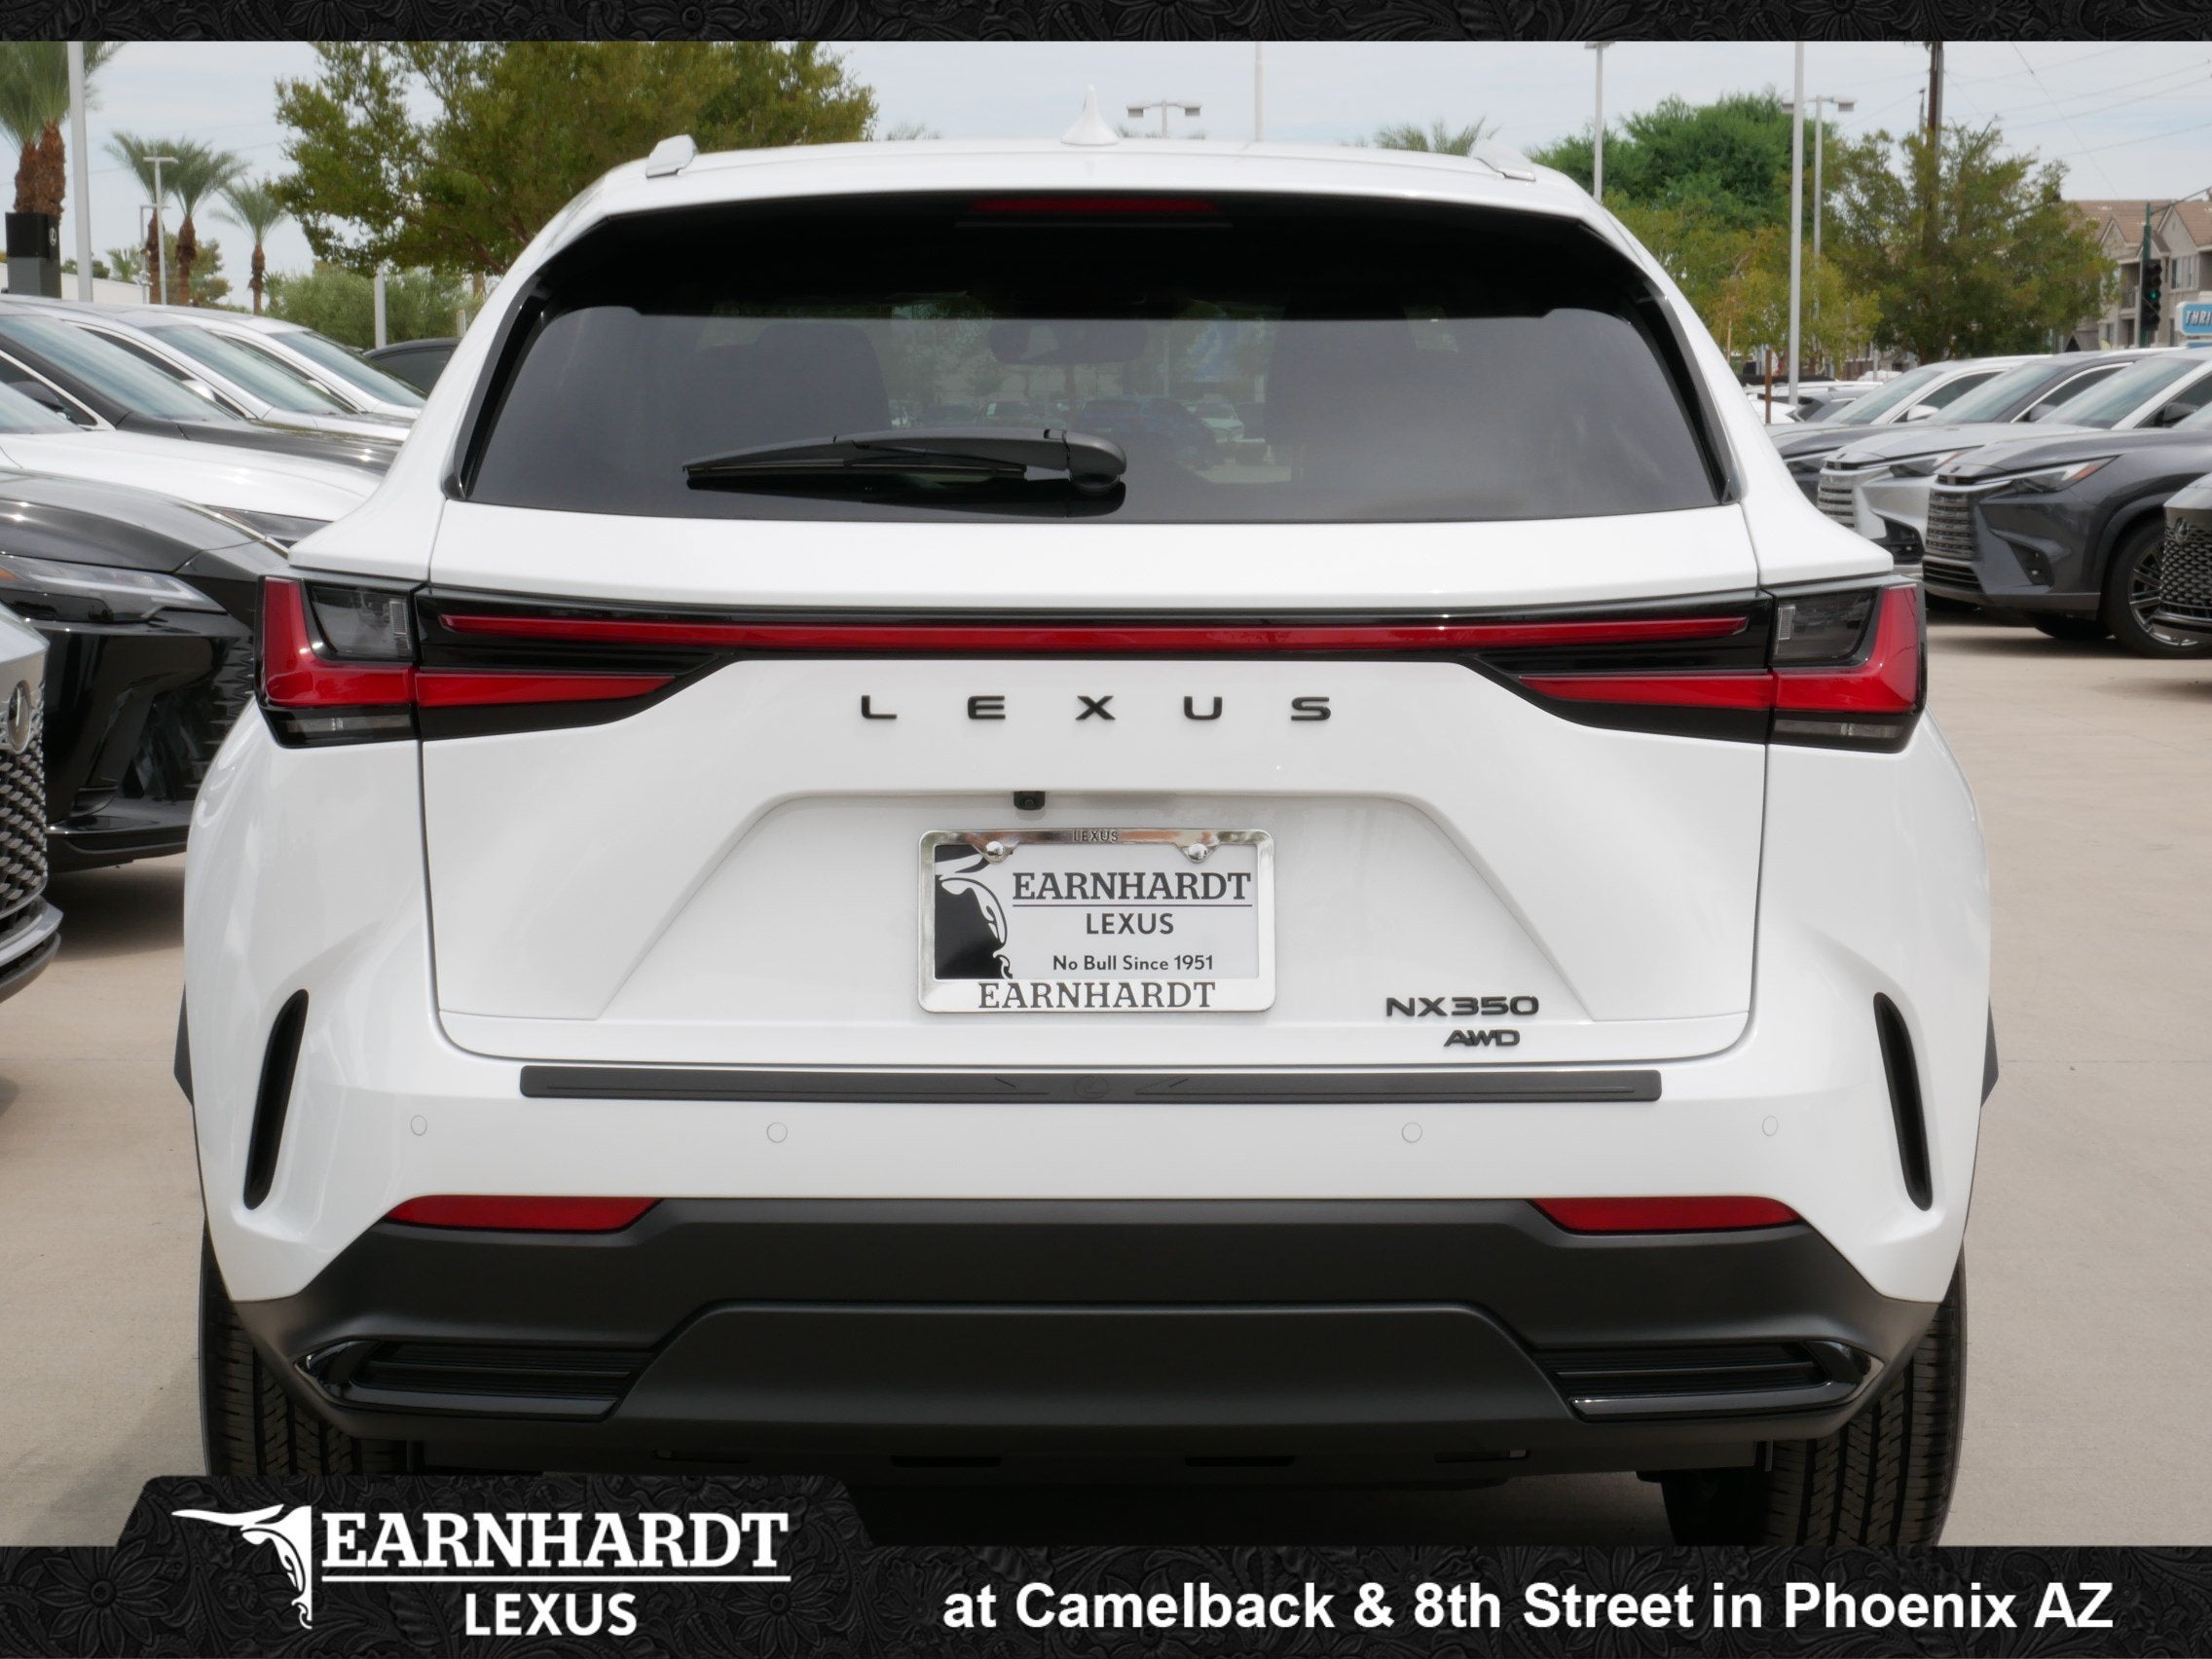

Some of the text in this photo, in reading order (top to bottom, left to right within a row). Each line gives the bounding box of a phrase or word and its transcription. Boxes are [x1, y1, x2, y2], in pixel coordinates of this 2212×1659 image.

[861, 694, 1332, 721] LEXUS
[1072, 830, 1120, 842] LEXUS
[1013, 871, 1251, 900] EARNHARDT
[1086, 912, 1174, 935] LEXUS
[1052, 954, 1214, 971] No Bull Since 1951
[977, 981, 1216, 1009] EARNHARDT
[1385, 995, 1539, 1017] NX350
[1443, 1029, 1521, 1048] AWD
